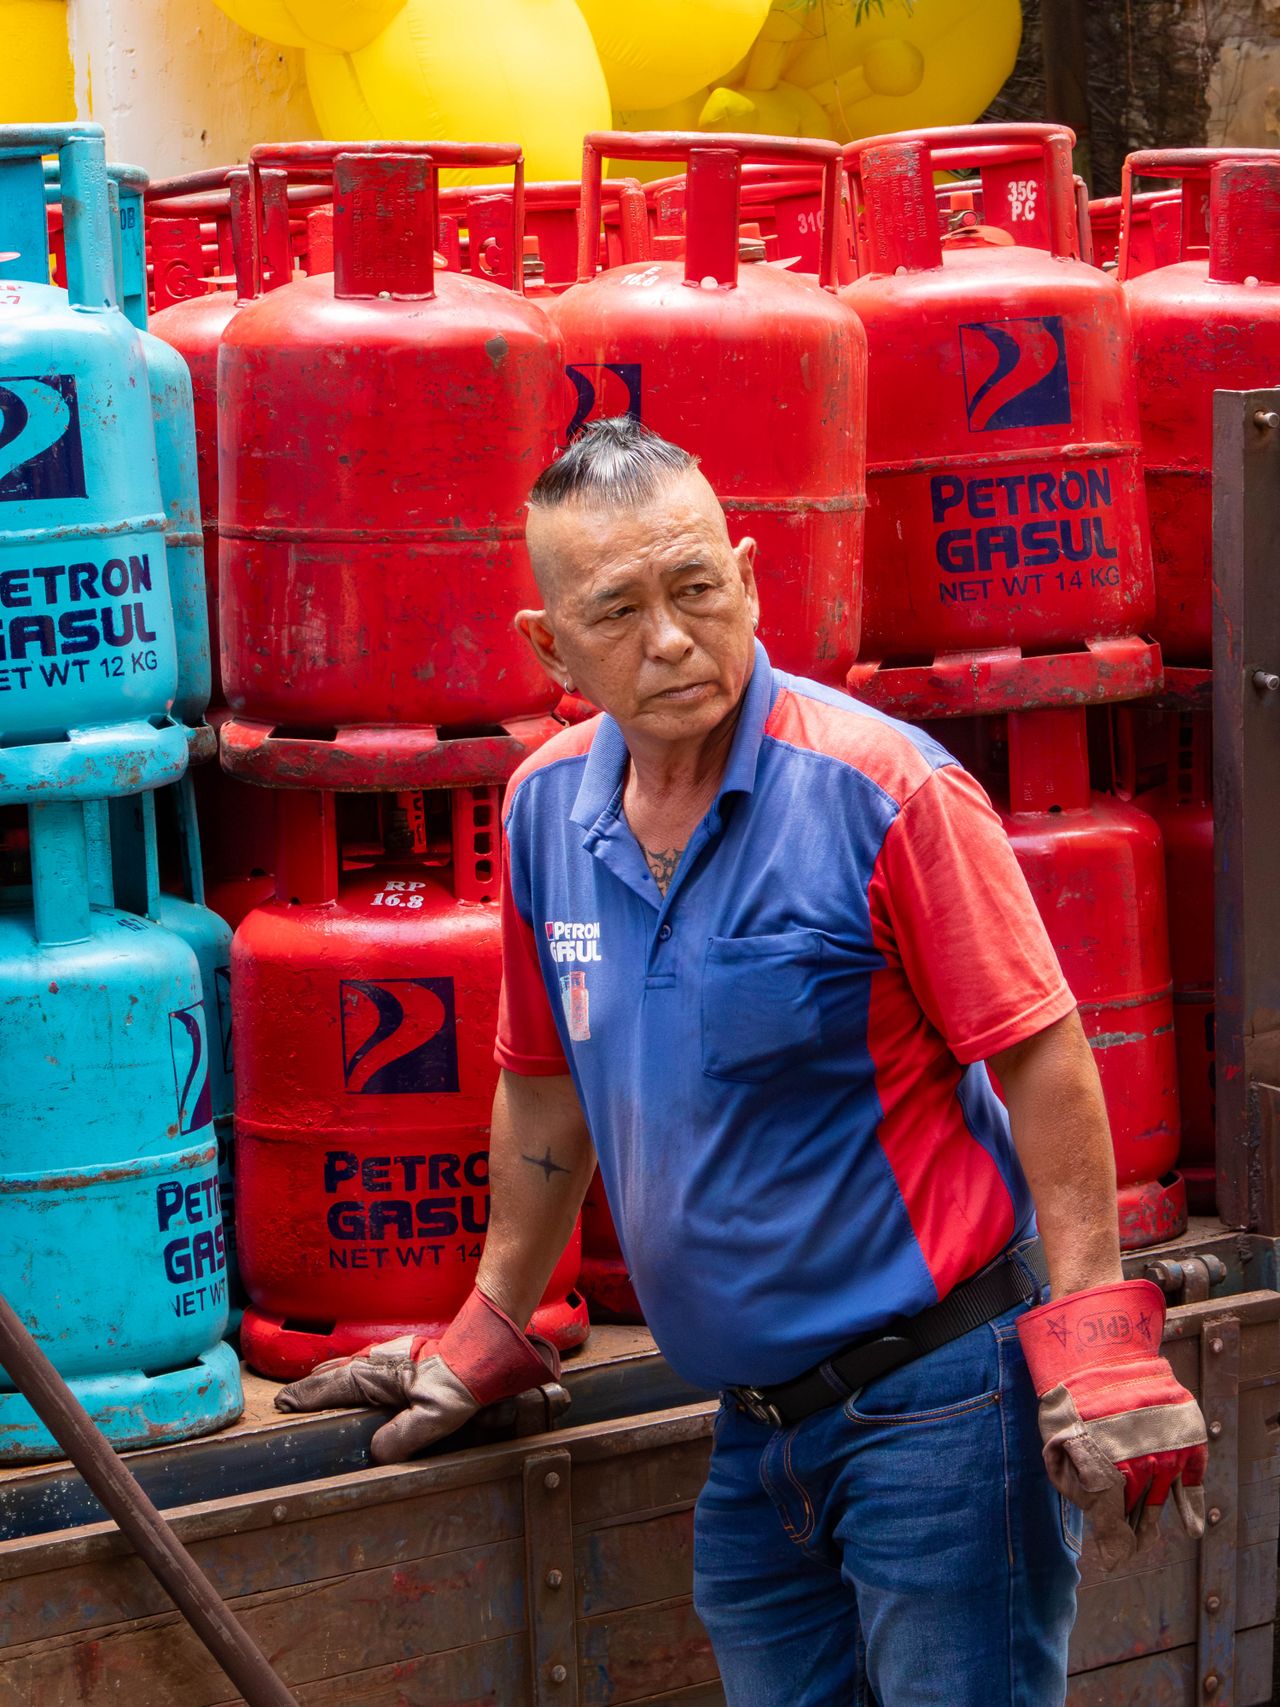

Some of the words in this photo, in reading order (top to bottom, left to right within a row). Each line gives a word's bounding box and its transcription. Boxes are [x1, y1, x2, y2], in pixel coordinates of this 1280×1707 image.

[1007, 180, 1037, 202] 35C
[1012, 200, 1035, 222] P.C
[931, 467, 1113, 524] PETRON
[936, 516, 1118, 574] GASUL
[0, 554, 152, 609] ETRON
[939, 578, 994, 603] NET
[1002, 573, 1046, 597] WT
[1091, 566, 1120, 587] KG
[0, 602, 157, 661] ASUL
[0, 667, 32, 691] ET
[40, 659, 90, 688] WT
[100, 656, 125, 678] 12
[131, 650, 158, 674] KG
[370, 893, 425, 909] 16.8
[384, 880, 427, 892] RP
[324, 1150, 490, 1194] PETRO
[327, 1194, 490, 1241] GASU
[163, 1223, 226, 1285] GAS
[330, 1247, 389, 1269] NET
[396, 1244, 445, 1267] WT
[456, 1241, 482, 1263] 14
[1083, 1315, 1130, 1342] EPIC
